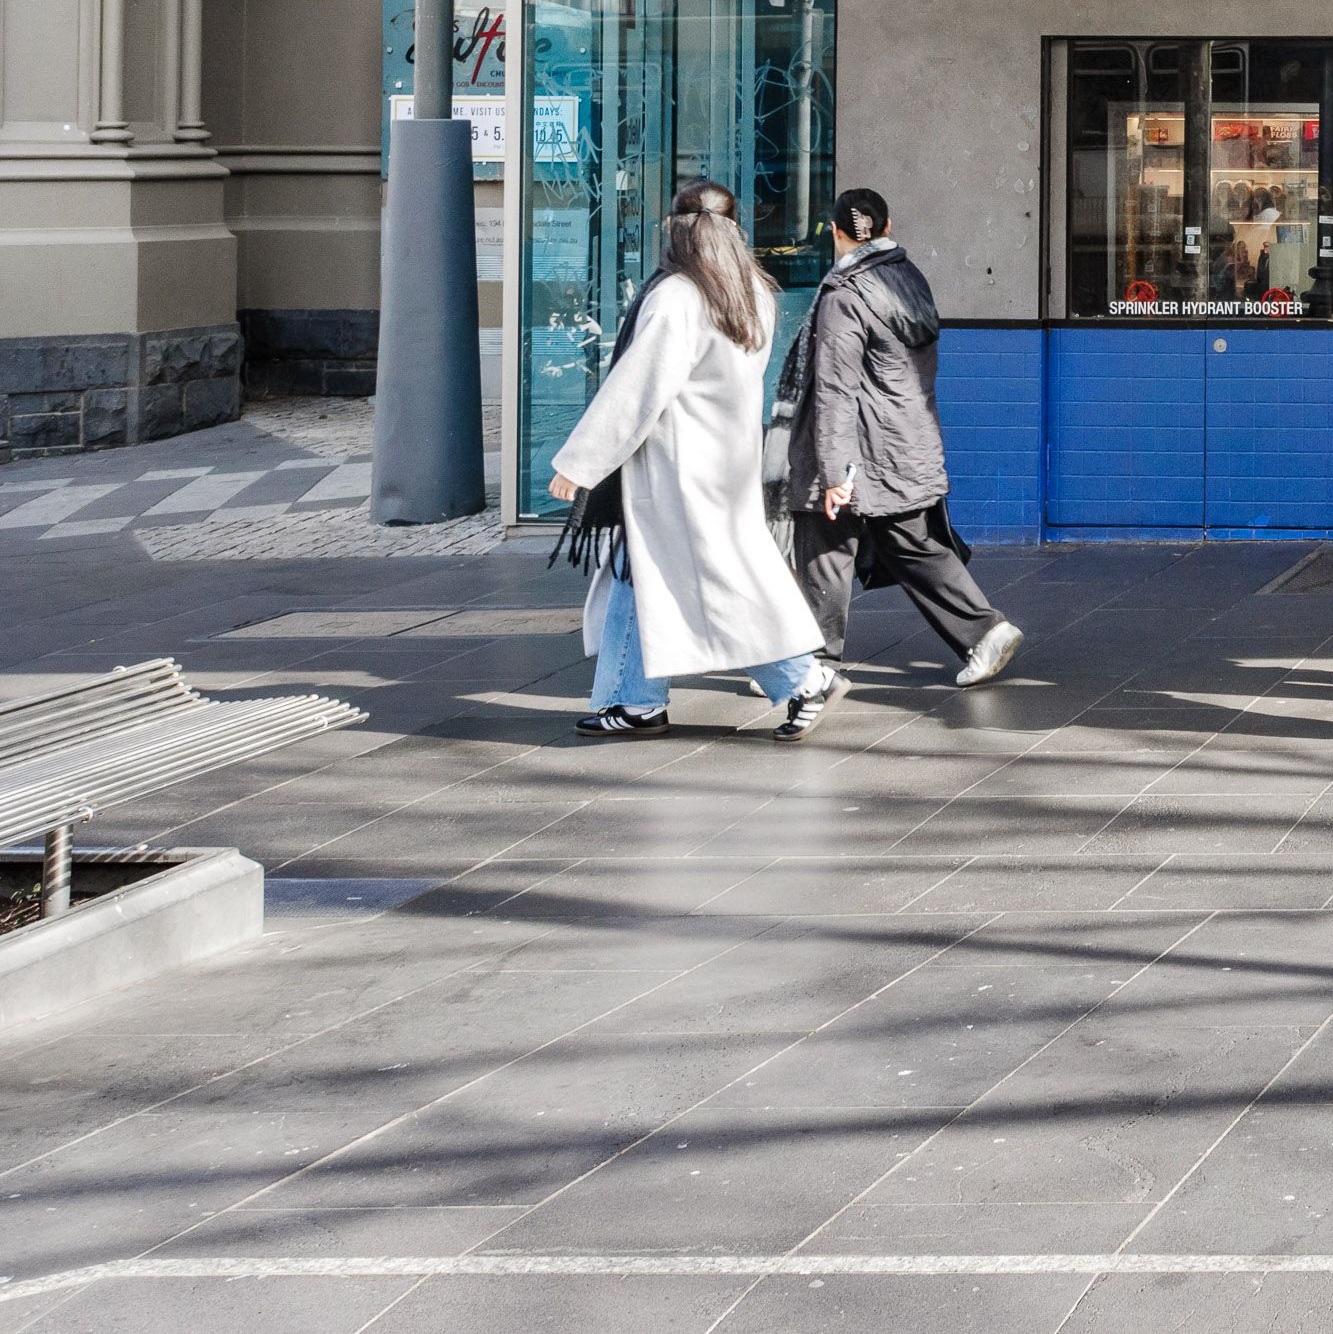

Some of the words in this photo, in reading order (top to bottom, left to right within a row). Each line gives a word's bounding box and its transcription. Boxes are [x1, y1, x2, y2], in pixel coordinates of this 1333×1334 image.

[470, 107, 492, 116] VISIT
[495, 107, 506, 116] US
[551, 219, 572, 228] Street
[1109, 300, 1179, 316] SPRINKLER
[1182, 300, 1242, 316] HYDRANT
[1244, 300, 1303, 316] BOOSTER
